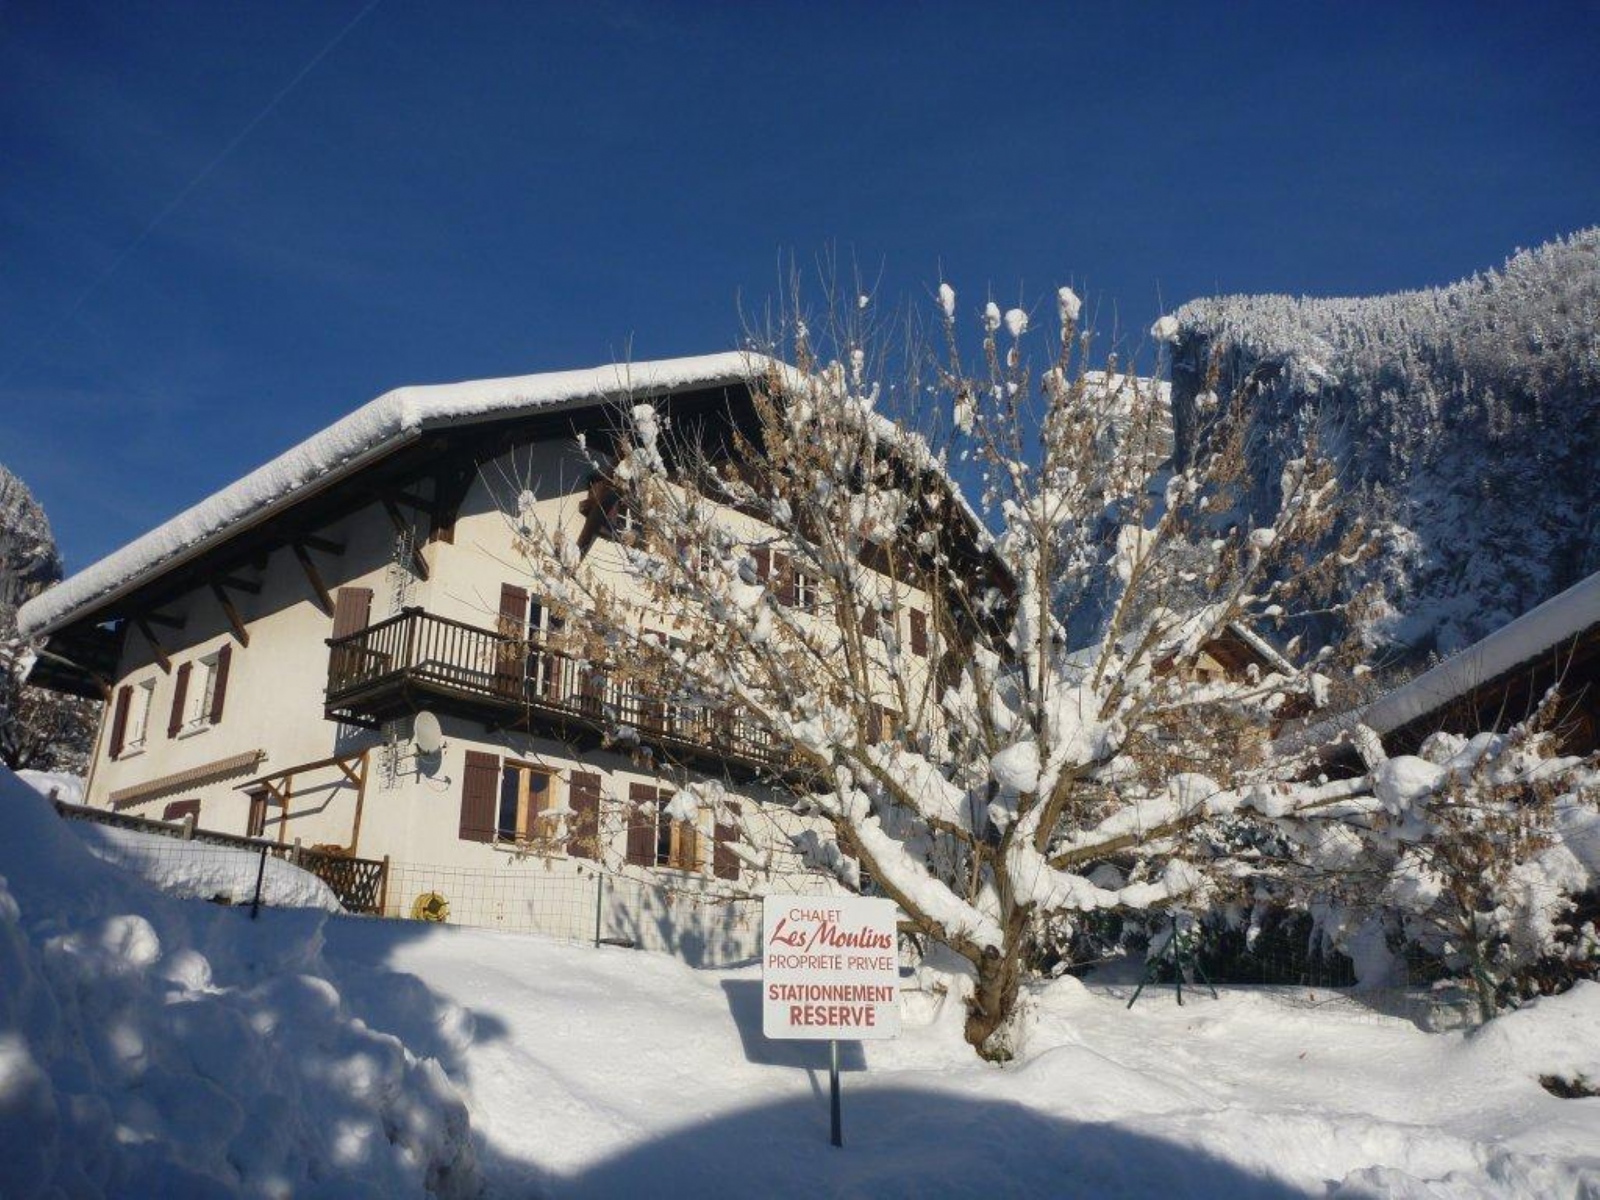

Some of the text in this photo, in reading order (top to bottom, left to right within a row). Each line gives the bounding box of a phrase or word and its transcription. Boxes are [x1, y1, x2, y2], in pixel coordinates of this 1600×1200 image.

[789, 908, 841, 922] CHALET
[769, 918, 892, 953] Les Moulins
[769, 984, 894, 1002] STATIONNEMENT
